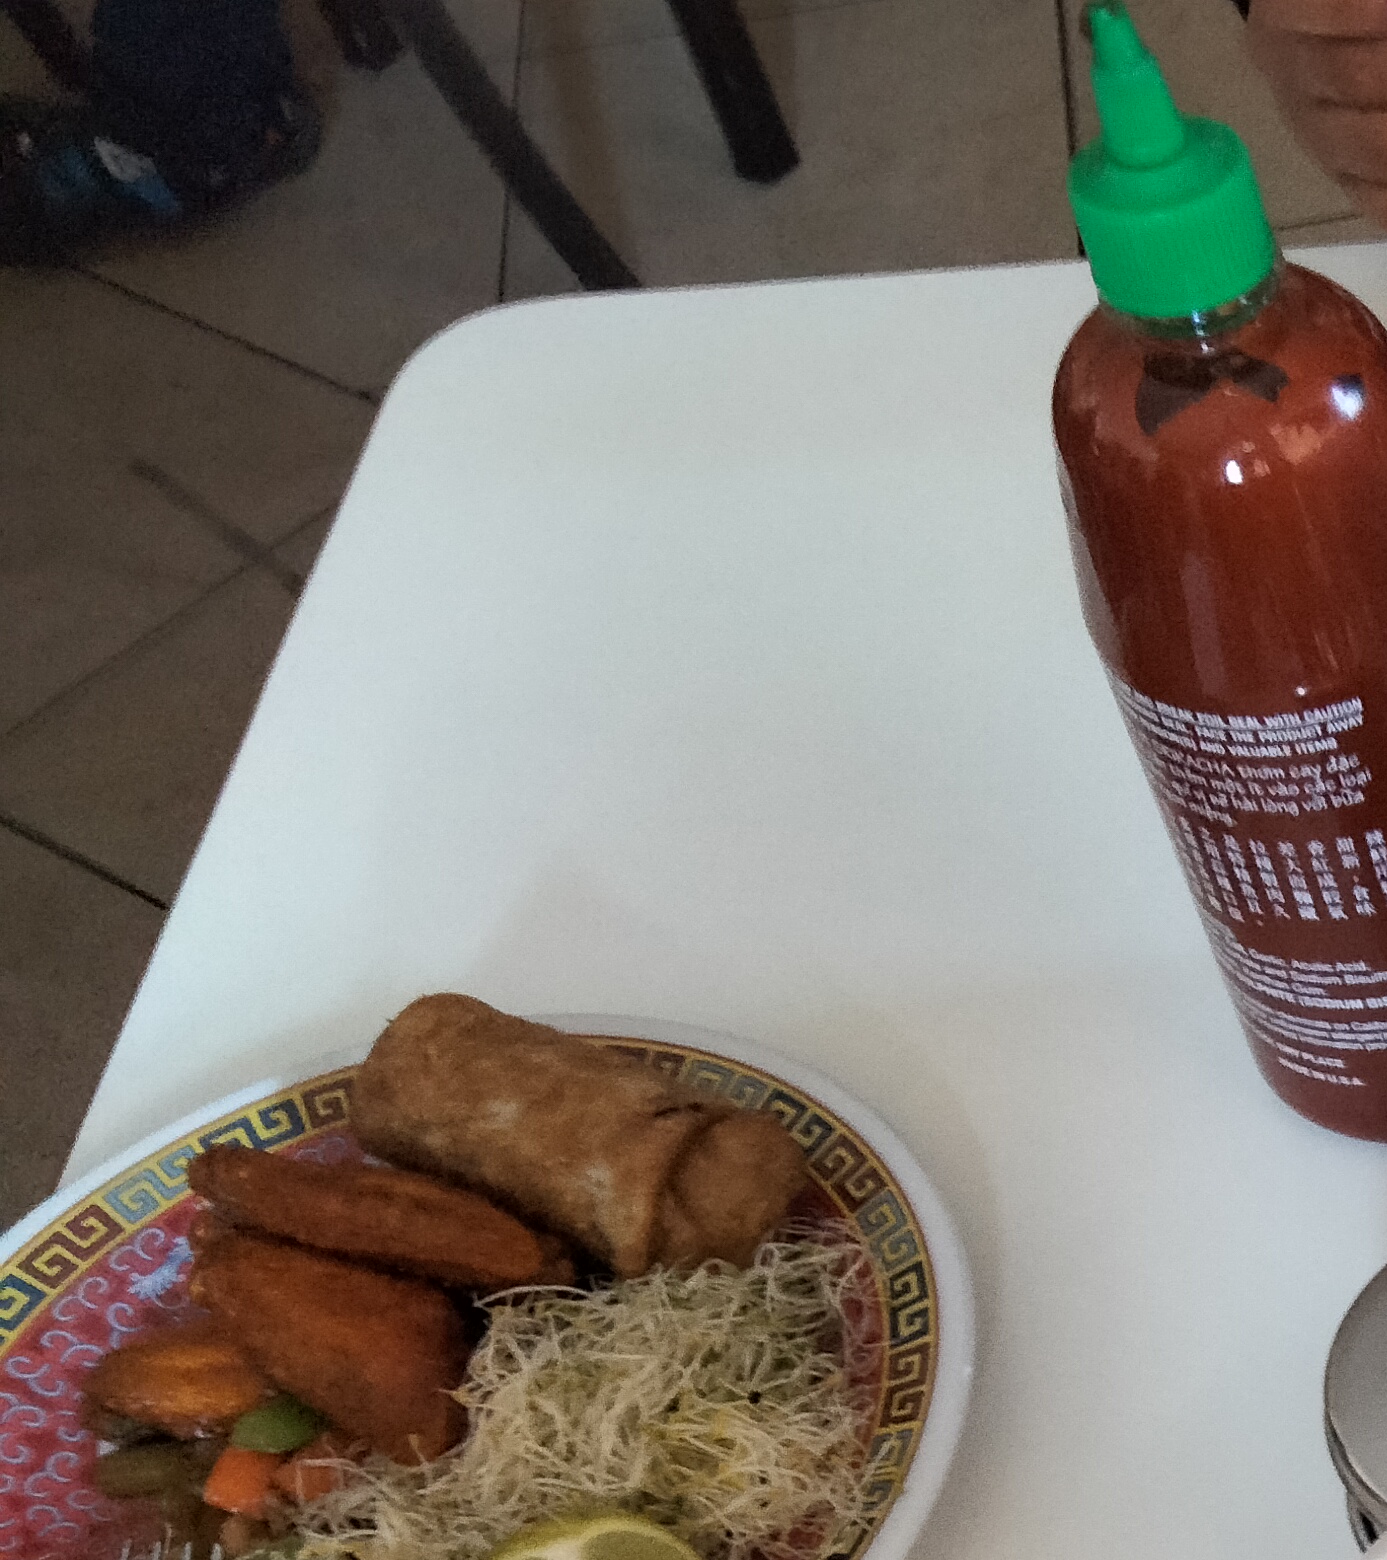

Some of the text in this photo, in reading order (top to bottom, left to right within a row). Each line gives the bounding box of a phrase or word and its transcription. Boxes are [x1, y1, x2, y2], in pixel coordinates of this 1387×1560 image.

[1263, 711, 1302, 730] WITH
[1302, 696, 1364, 724] CAUTION
[1325, 713, 1364, 735] AWAY
